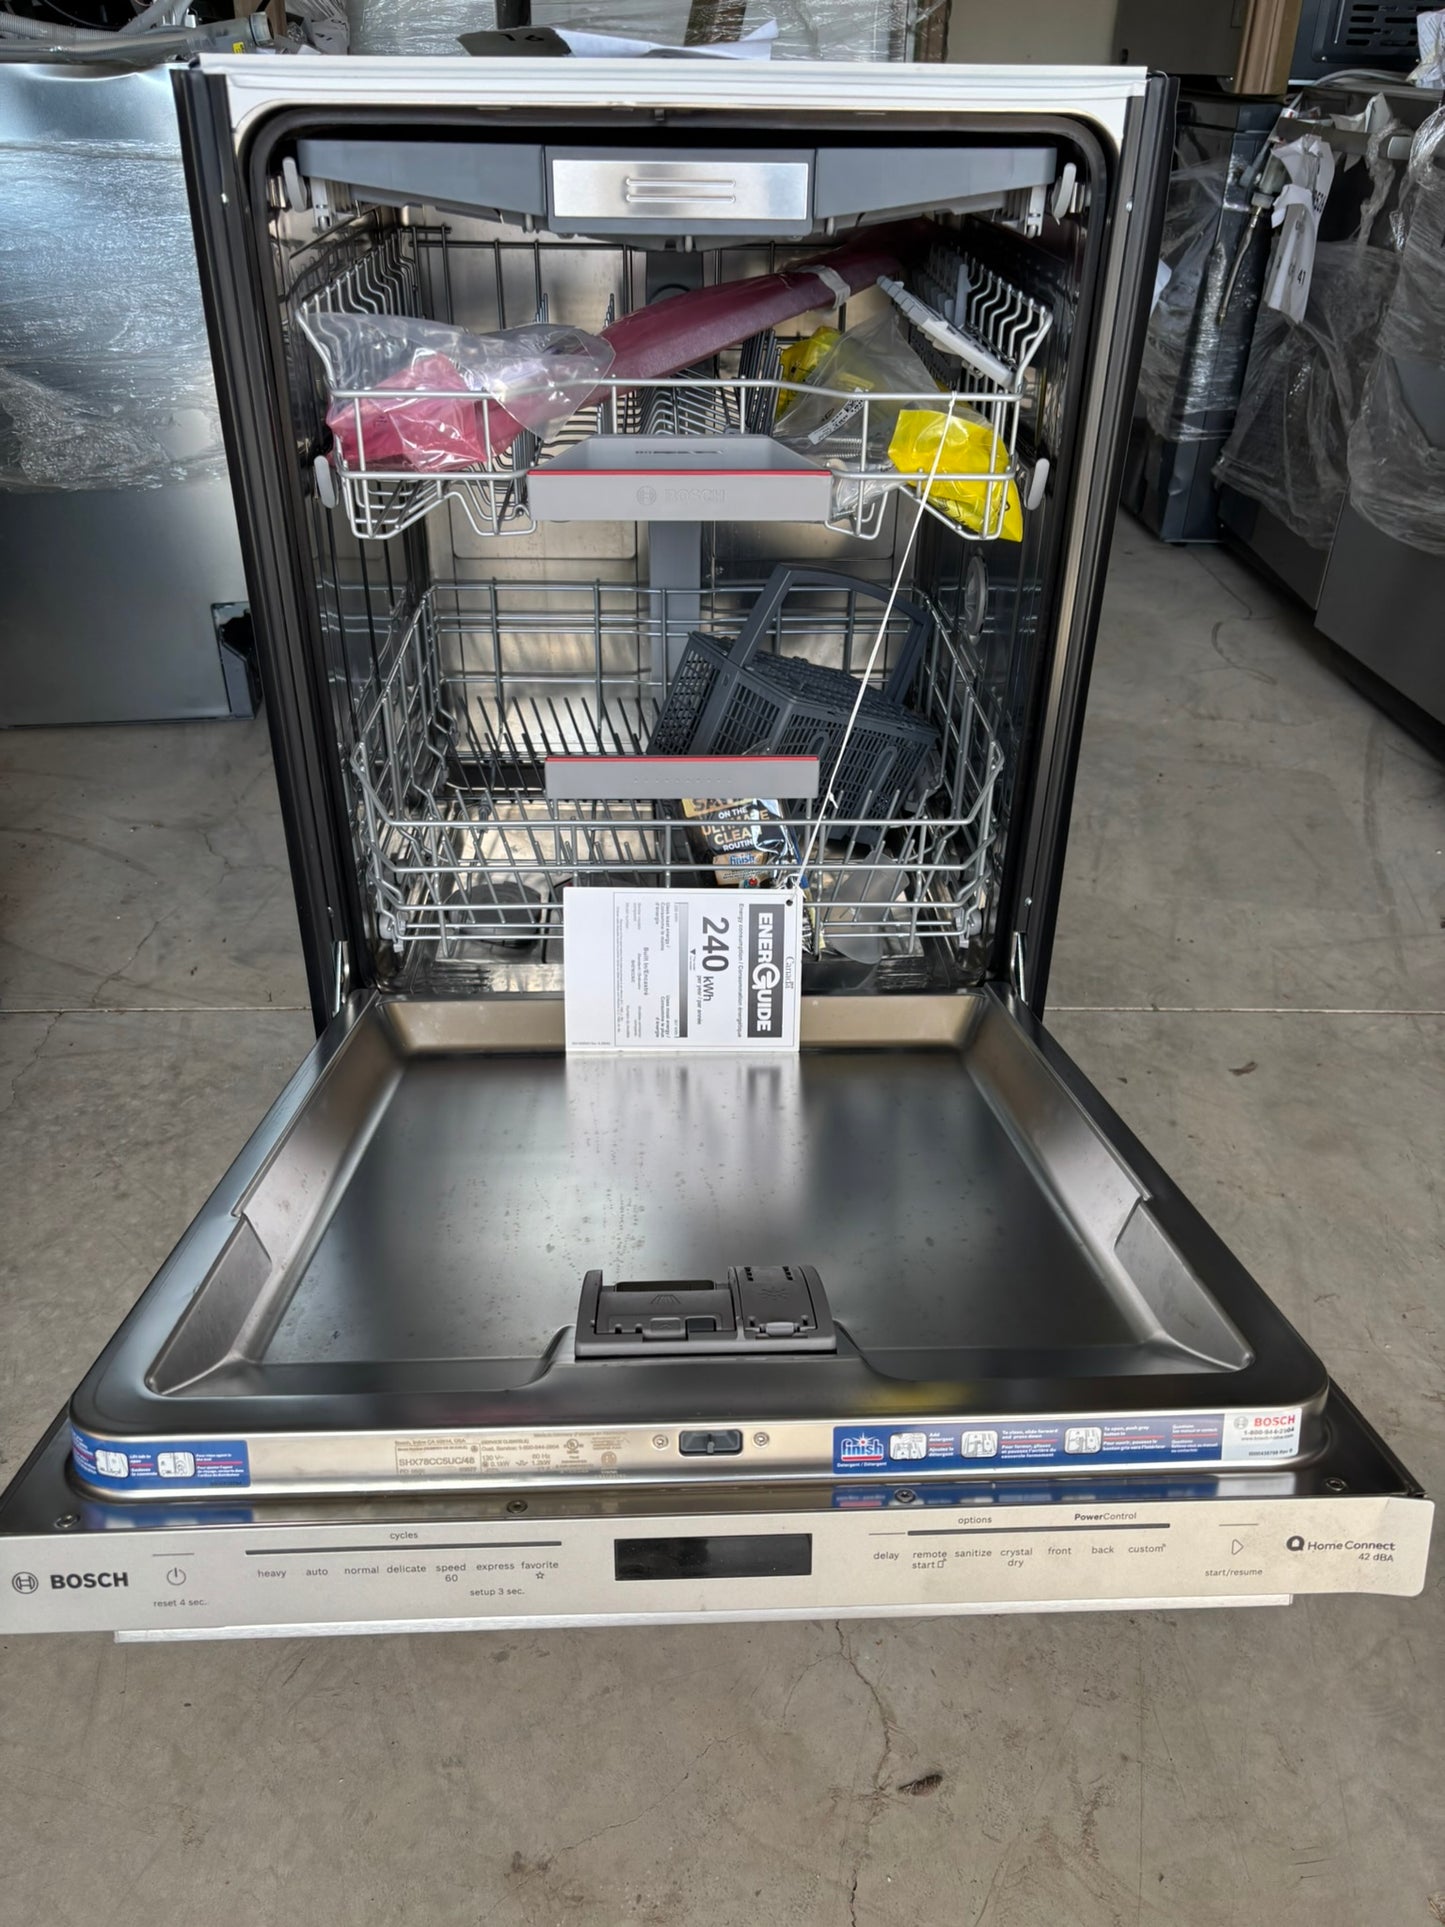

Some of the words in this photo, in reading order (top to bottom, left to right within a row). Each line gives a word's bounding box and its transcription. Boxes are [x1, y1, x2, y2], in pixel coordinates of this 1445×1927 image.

[718, 810, 730, 819] ON
[731, 807, 748, 815] THE
[723, 838, 755, 852] ROUTIN
[702, 916, 730, 972] 240
[752, 912, 781, 1032] ENERGUIDE
[785, 956, 795, 989] Canada
[703, 976, 713, 1002] kWh
[1254, 1414, 1295, 1427] BOSCH
[841, 1438, 884, 1457] finish
[958, 1516, 992, 1525] options
[1074, 1512, 1137, 1521] PowerControl
[389, 1531, 419, 1541] cycles
[1047, 1545, 1072, 1555] front
[1091, 1544, 1115, 1554] back
[1308, 1540, 1343, 1551] Home
[1344, 1540, 1395, 1552] Connect
[873, 1551, 900, 1562] delay
[912, 1550, 948, 1559] remote
[954, 1549, 993, 1558] sanitize
[1000, 1547, 1033, 1558] crystal
[1358, 1553, 1371, 1562] 42
[1373, 1552, 1394, 1562] dBA
[435, 1562, 467, 1573] speed
[476, 1562, 515, 1573] express
[521, 1560, 559, 1571] favorite
[912, 1560, 935, 1569] start
[1007, 1558, 1024, 1568] dry
[257, 1569, 287, 1579] heavy
[306, 1567, 329, 1577] auto
[344, 1565, 380, 1575] normal
[387, 1564, 427, 1574] delicate
[1205, 1567, 1263, 1577] start/resume
[50, 1571, 129, 1590] BOSCH
[445, 1573, 458, 1583] 60
[470, 1587, 496, 1598] setup
[498, 1587, 505, 1596] 3
[506, 1587, 525, 1596] sec.
[153, 1599, 177, 1608] reset
[179, 1599, 186, 1607] 4
[188, 1599, 208, 1607] sec.
